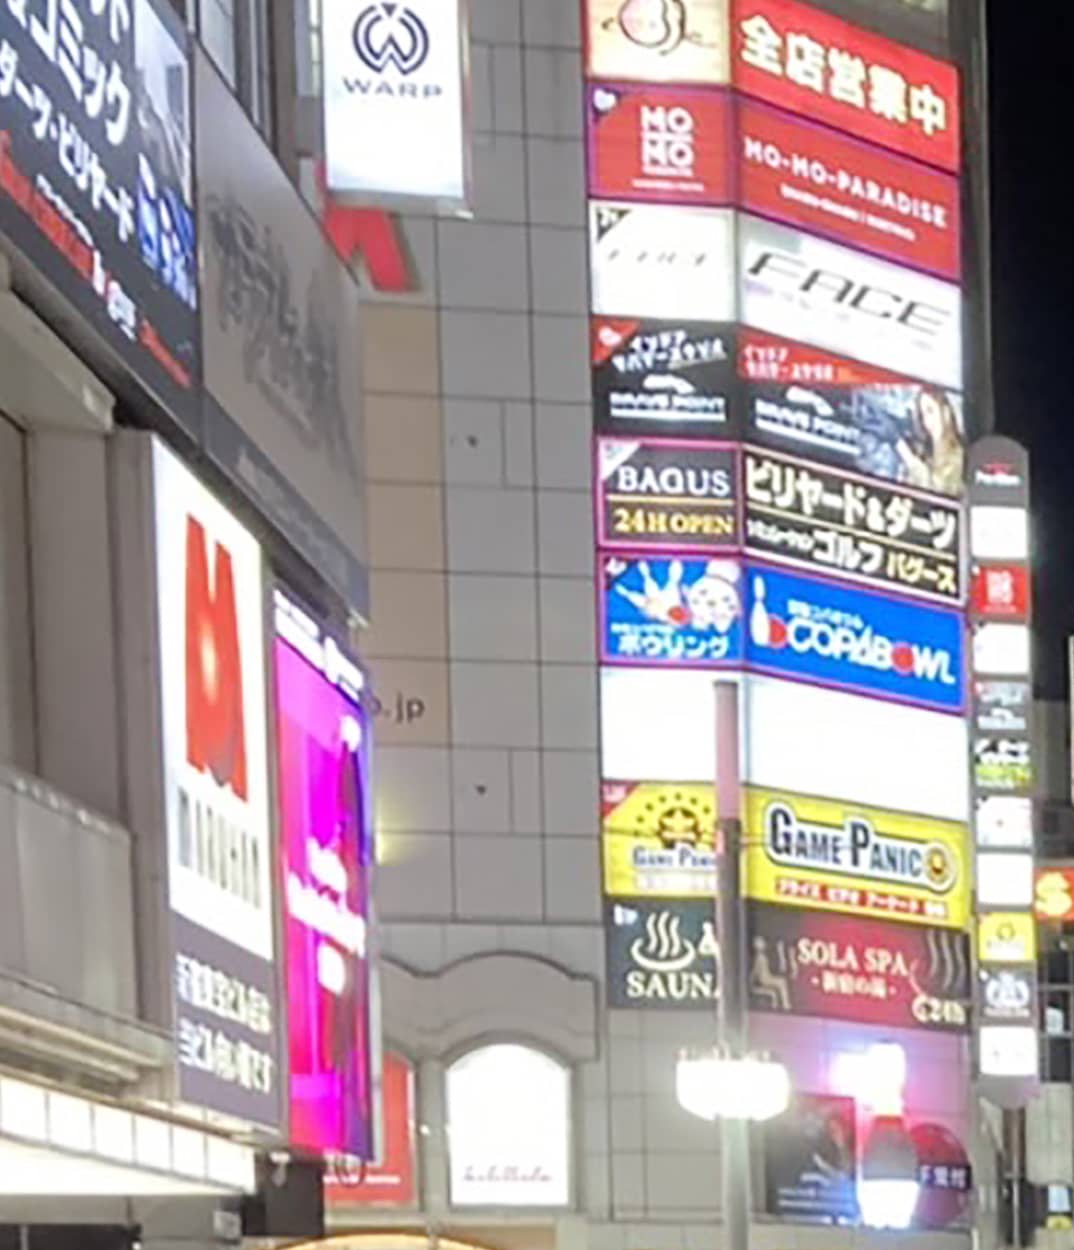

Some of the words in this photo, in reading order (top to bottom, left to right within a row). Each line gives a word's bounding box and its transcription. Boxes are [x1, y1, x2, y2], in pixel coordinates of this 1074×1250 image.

[343, 76, 442, 98] WARP
[741, 14, 946, 136] 全店営業中
[640, 105, 694, 134] MO
[641, 136, 694, 166] MO
[743, 136, 947, 229] MO-MO-PARADISE
[747, 252, 952, 336] FACE
[812, 529, 884, 573] ゴルフ
[617, 634, 731, 659] ボウリング
[769, 806, 843, 866] GAME
[849, 820, 924, 879] PANIC
[797, 936, 858, 971] SOLA
[864, 946, 909, 977] SPA
[626, 970, 721, 999] SAUN
